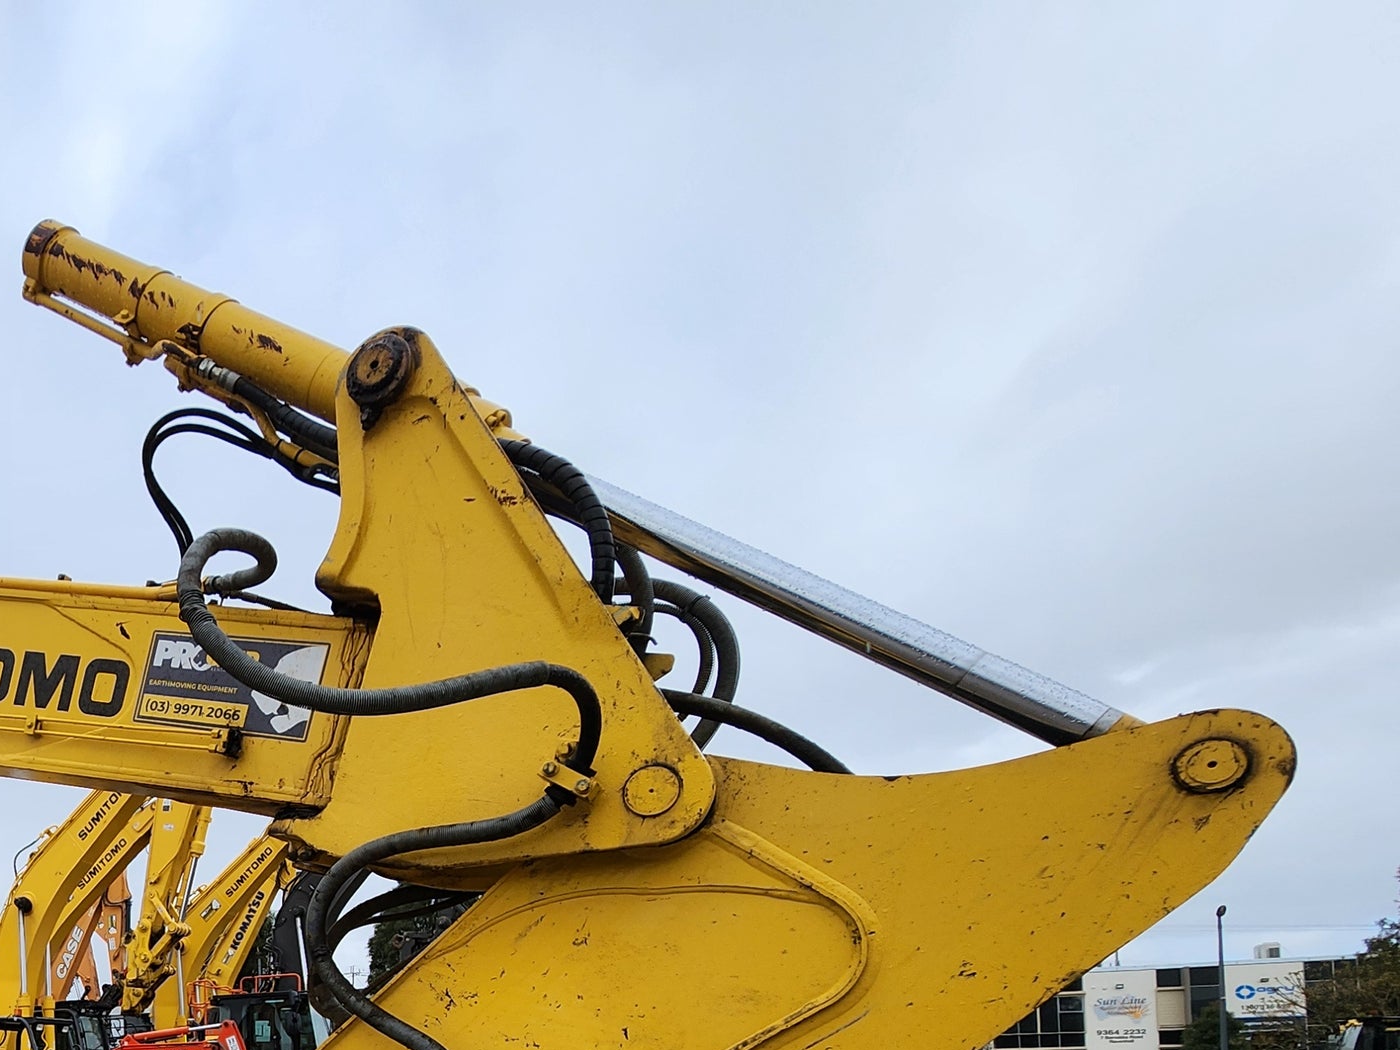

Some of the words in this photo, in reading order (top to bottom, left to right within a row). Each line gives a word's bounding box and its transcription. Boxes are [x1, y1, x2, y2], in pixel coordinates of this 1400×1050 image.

[145, 700, 170, 715] (03)
[173, 702, 203, 717] 9971
[206, 707, 241, 722] 2066
[149, 678, 196, 691] EARTHMOVING
[197, 683, 238, 695] EQUIPMENT
[77, 838, 127, 890] SUMITOMO
[225, 846, 273, 898] SUMITOMO
[231, 890, 265, 951] KOMATSU
[56, 925, 84, 979] CASE
[1094, 998, 1117, 1007] Sun
[1120, 996, 1147, 1005] Line
